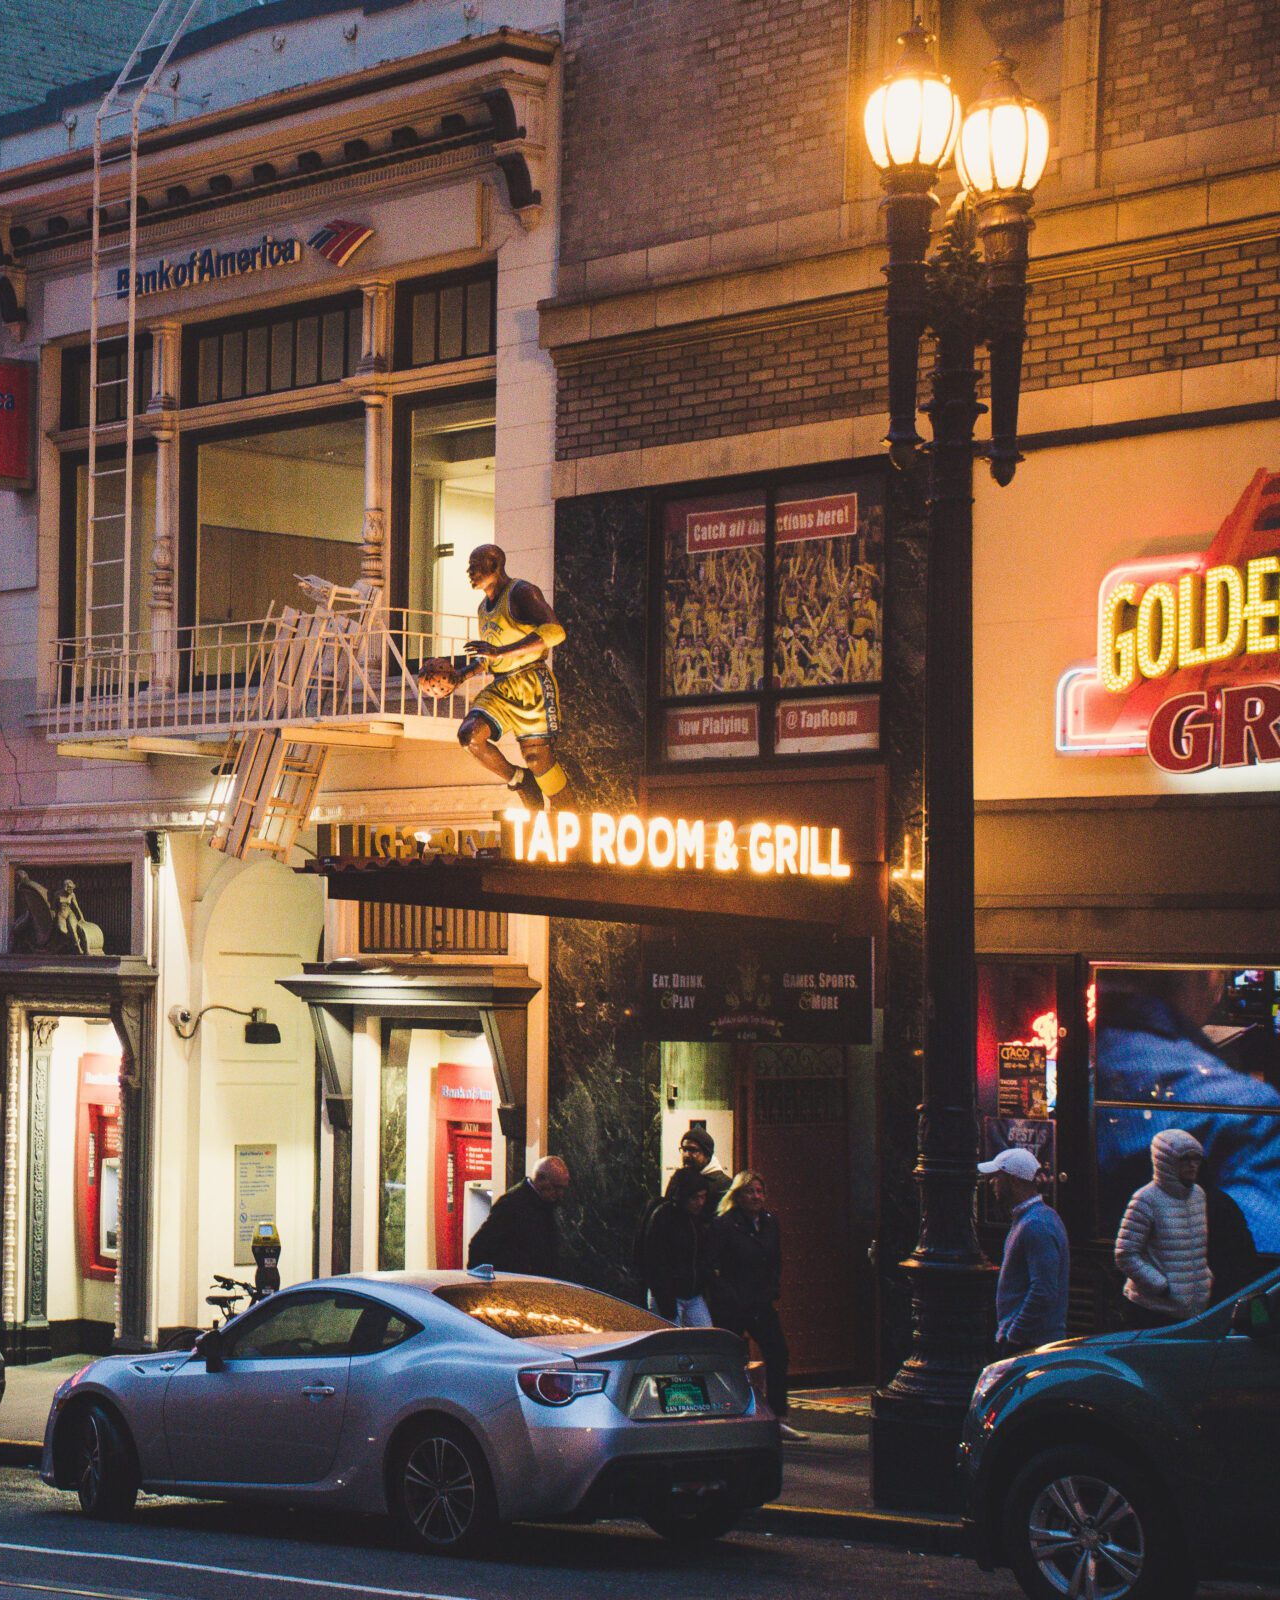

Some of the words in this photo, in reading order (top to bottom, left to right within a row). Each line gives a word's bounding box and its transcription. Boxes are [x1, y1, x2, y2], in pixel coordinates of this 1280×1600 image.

[117, 258, 173, 300] Bank
[174, 251, 201, 288] of
[200, 234, 300, 282] America
[693, 521, 724, 543] Catch
[729, 518, 746, 538] all
[747, 515, 766, 534] the
[776, 509, 814, 532] ctions
[816, 503, 850, 527] here!
[1099, 555, 1280, 694] GOLDE
[785, 711, 799, 730] @
[504, 808, 580, 863] TAP
[591, 813, 705, 869] ROOM
[713, 819, 740, 871] &
[748, 822, 851, 878] GRILL
[464, 1123, 479, 1132] ATM
[678, 1403, 711, 1412] FRANCISCO
